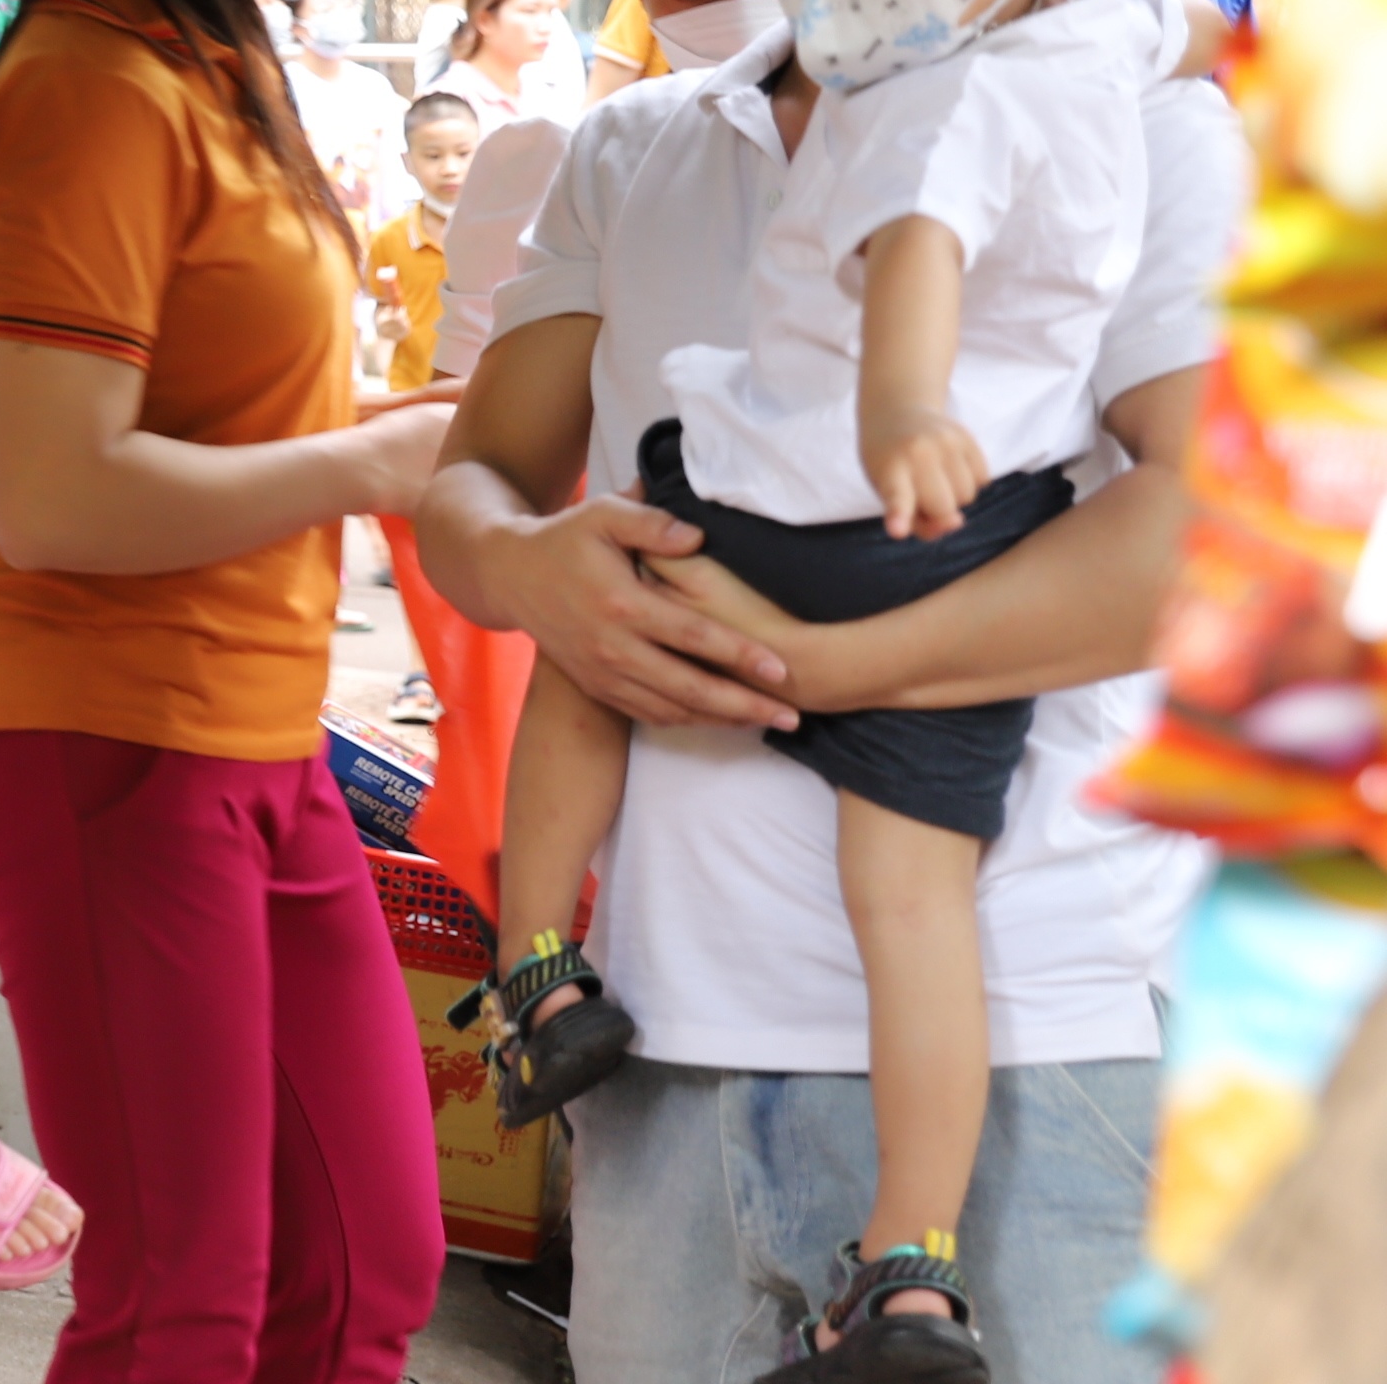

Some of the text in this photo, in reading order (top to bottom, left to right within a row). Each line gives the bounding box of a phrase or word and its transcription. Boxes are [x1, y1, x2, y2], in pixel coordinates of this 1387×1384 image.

[353, 756, 407, 790] REMOTE
[344, 784, 393, 819] REMOTE
[383, 784, 417, 809] SPEED
